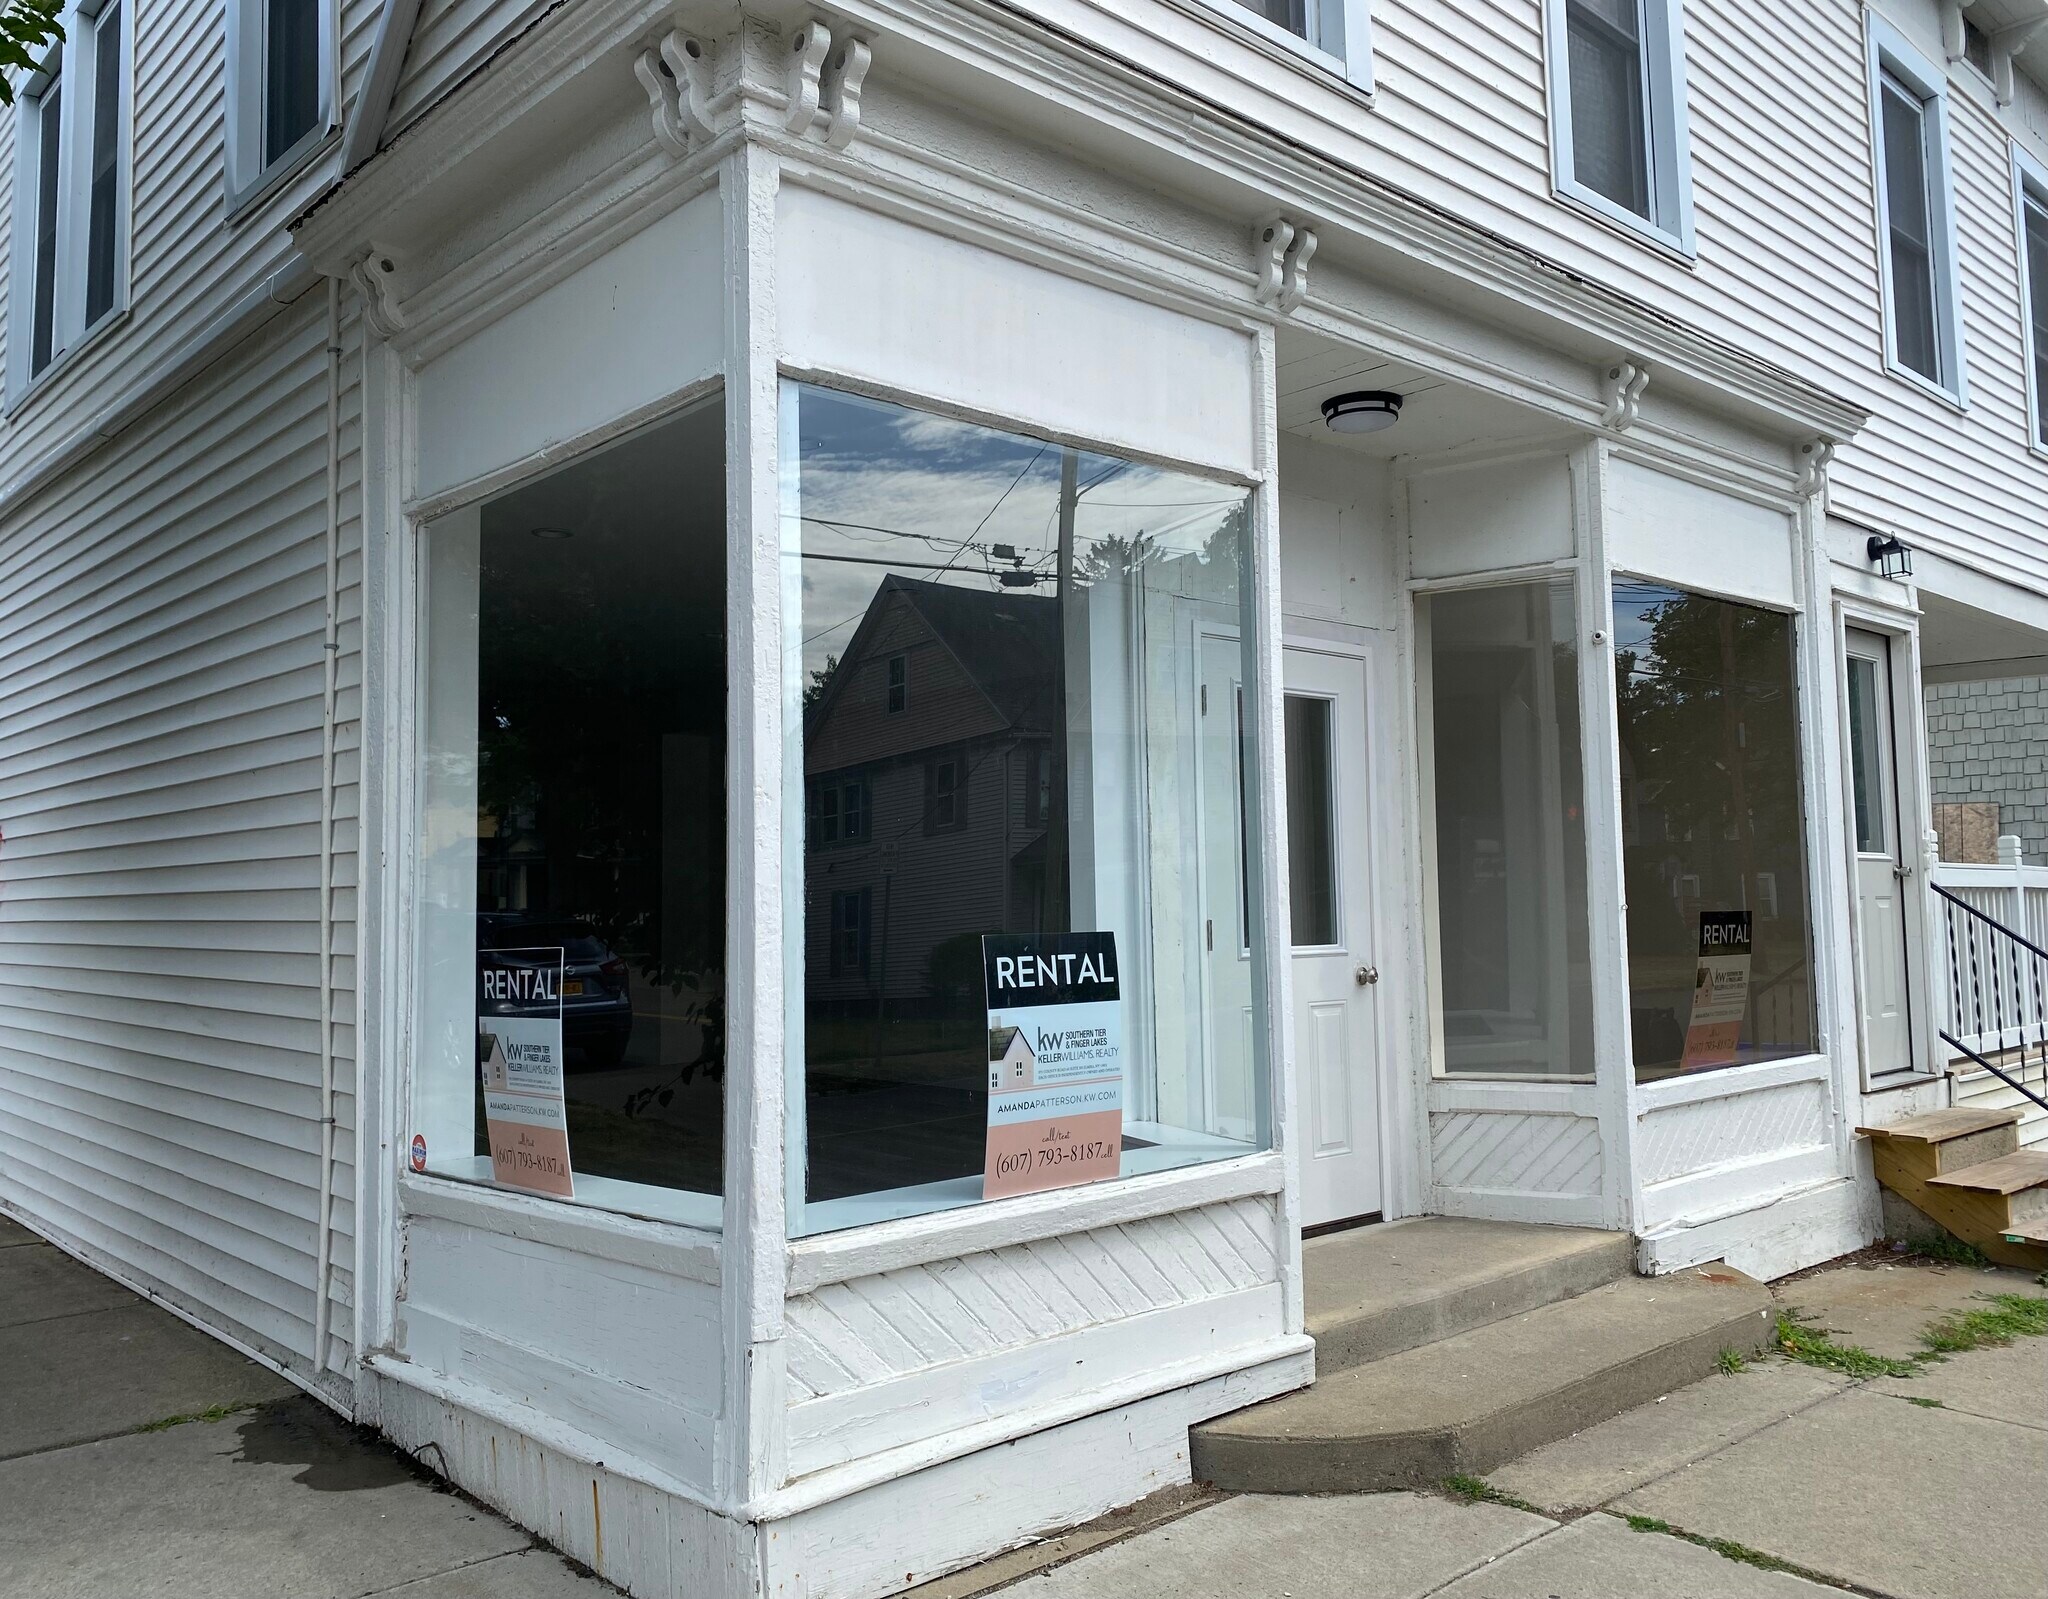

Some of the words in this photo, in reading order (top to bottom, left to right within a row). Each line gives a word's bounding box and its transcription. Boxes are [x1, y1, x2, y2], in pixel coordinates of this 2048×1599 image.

[1703, 924, 1750, 945] RENTAL
[996, 952, 1115, 989] RENTAL
[483, 969, 557, 1000] RENTAL
[1065, 1029, 1094, 1040] SOUTHERN
[1094, 1028, 1107, 1037] TIER
[1065, 1041, 1070, 1050] &
[1070, 1039, 1091, 1049] FINGER
[1091, 1037, 1108, 1047] LAKES
[1095, 1046, 1120, 1058] REALTY
[997, 1091, 1117, 1114] AMANDAPATTERSON.KW.COM
[496, 1143, 517, 1171] (607)
[517, 1151, 557, 1174] 793-8187
[996, 1148, 1033, 1179] (607)
[1038, 1141, 1102, 1168] 793-8187
